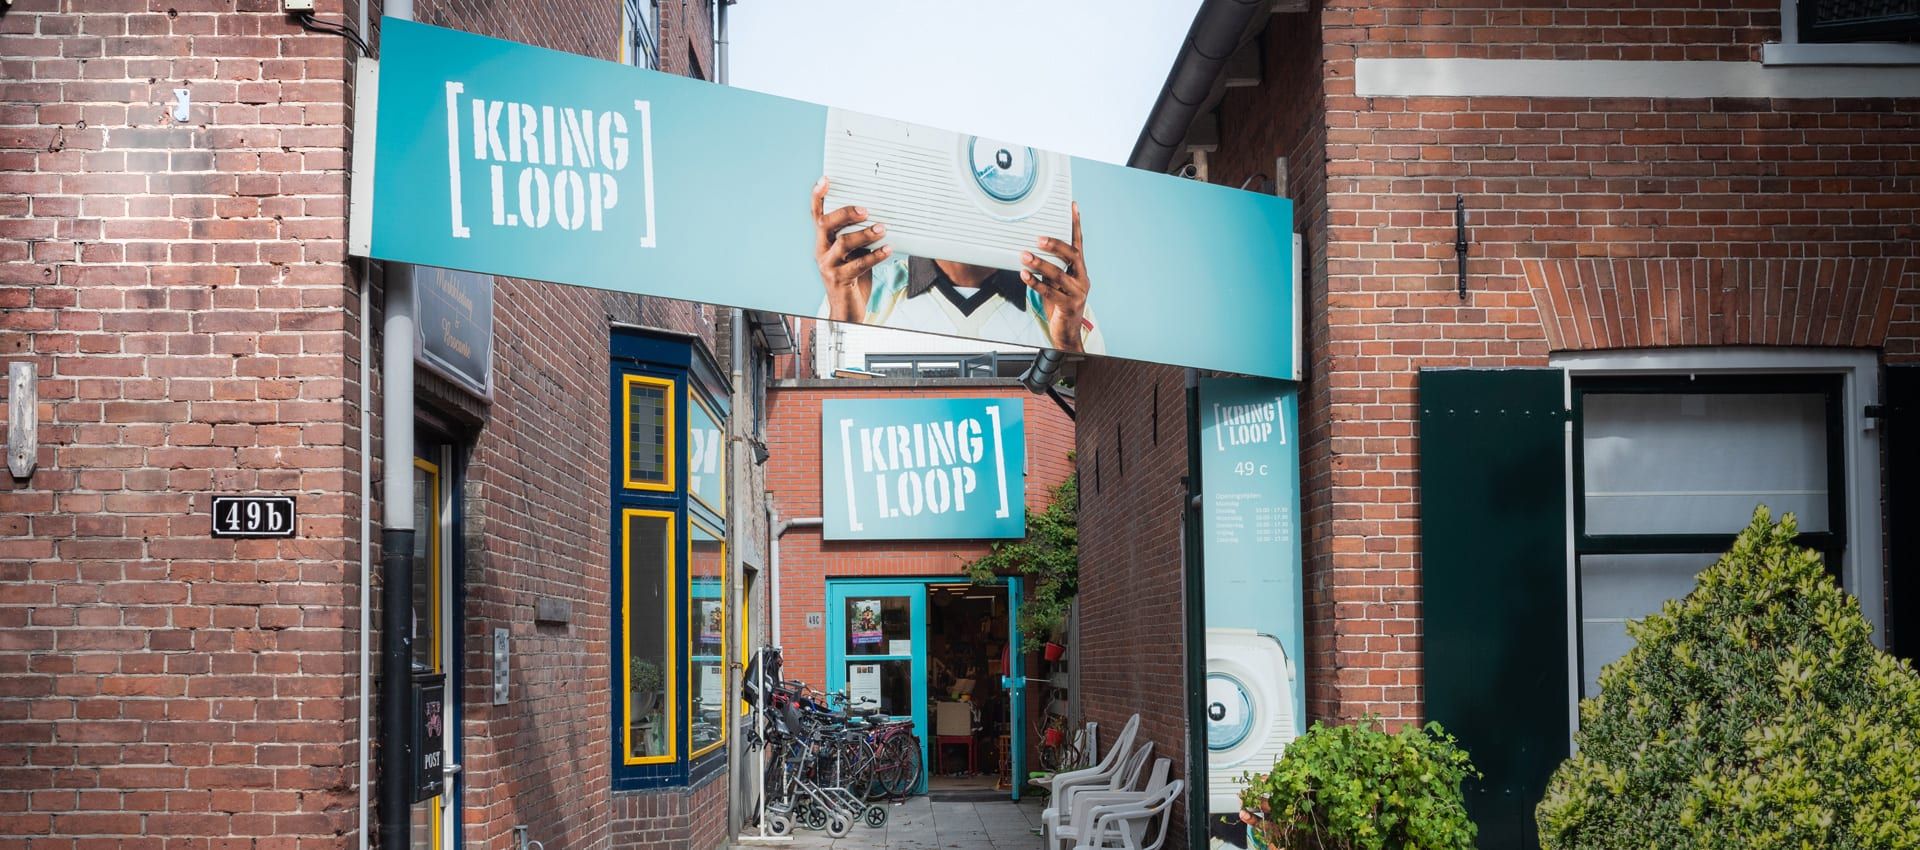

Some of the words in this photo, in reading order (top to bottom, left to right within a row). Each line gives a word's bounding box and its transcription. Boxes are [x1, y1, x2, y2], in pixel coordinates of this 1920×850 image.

[472, 98, 629, 171] KRING
[490, 164, 618, 231] LOOP
[1222, 402, 1275, 426] KRING
[860, 418, 984, 473] KRING
[1229, 422, 1272, 446] LOOP
[1234, 461, 1254, 476] 49
[1259, 465, 1268, 476] c
[876, 466, 977, 519] LOOP
[424, 751, 441, 769] POST
